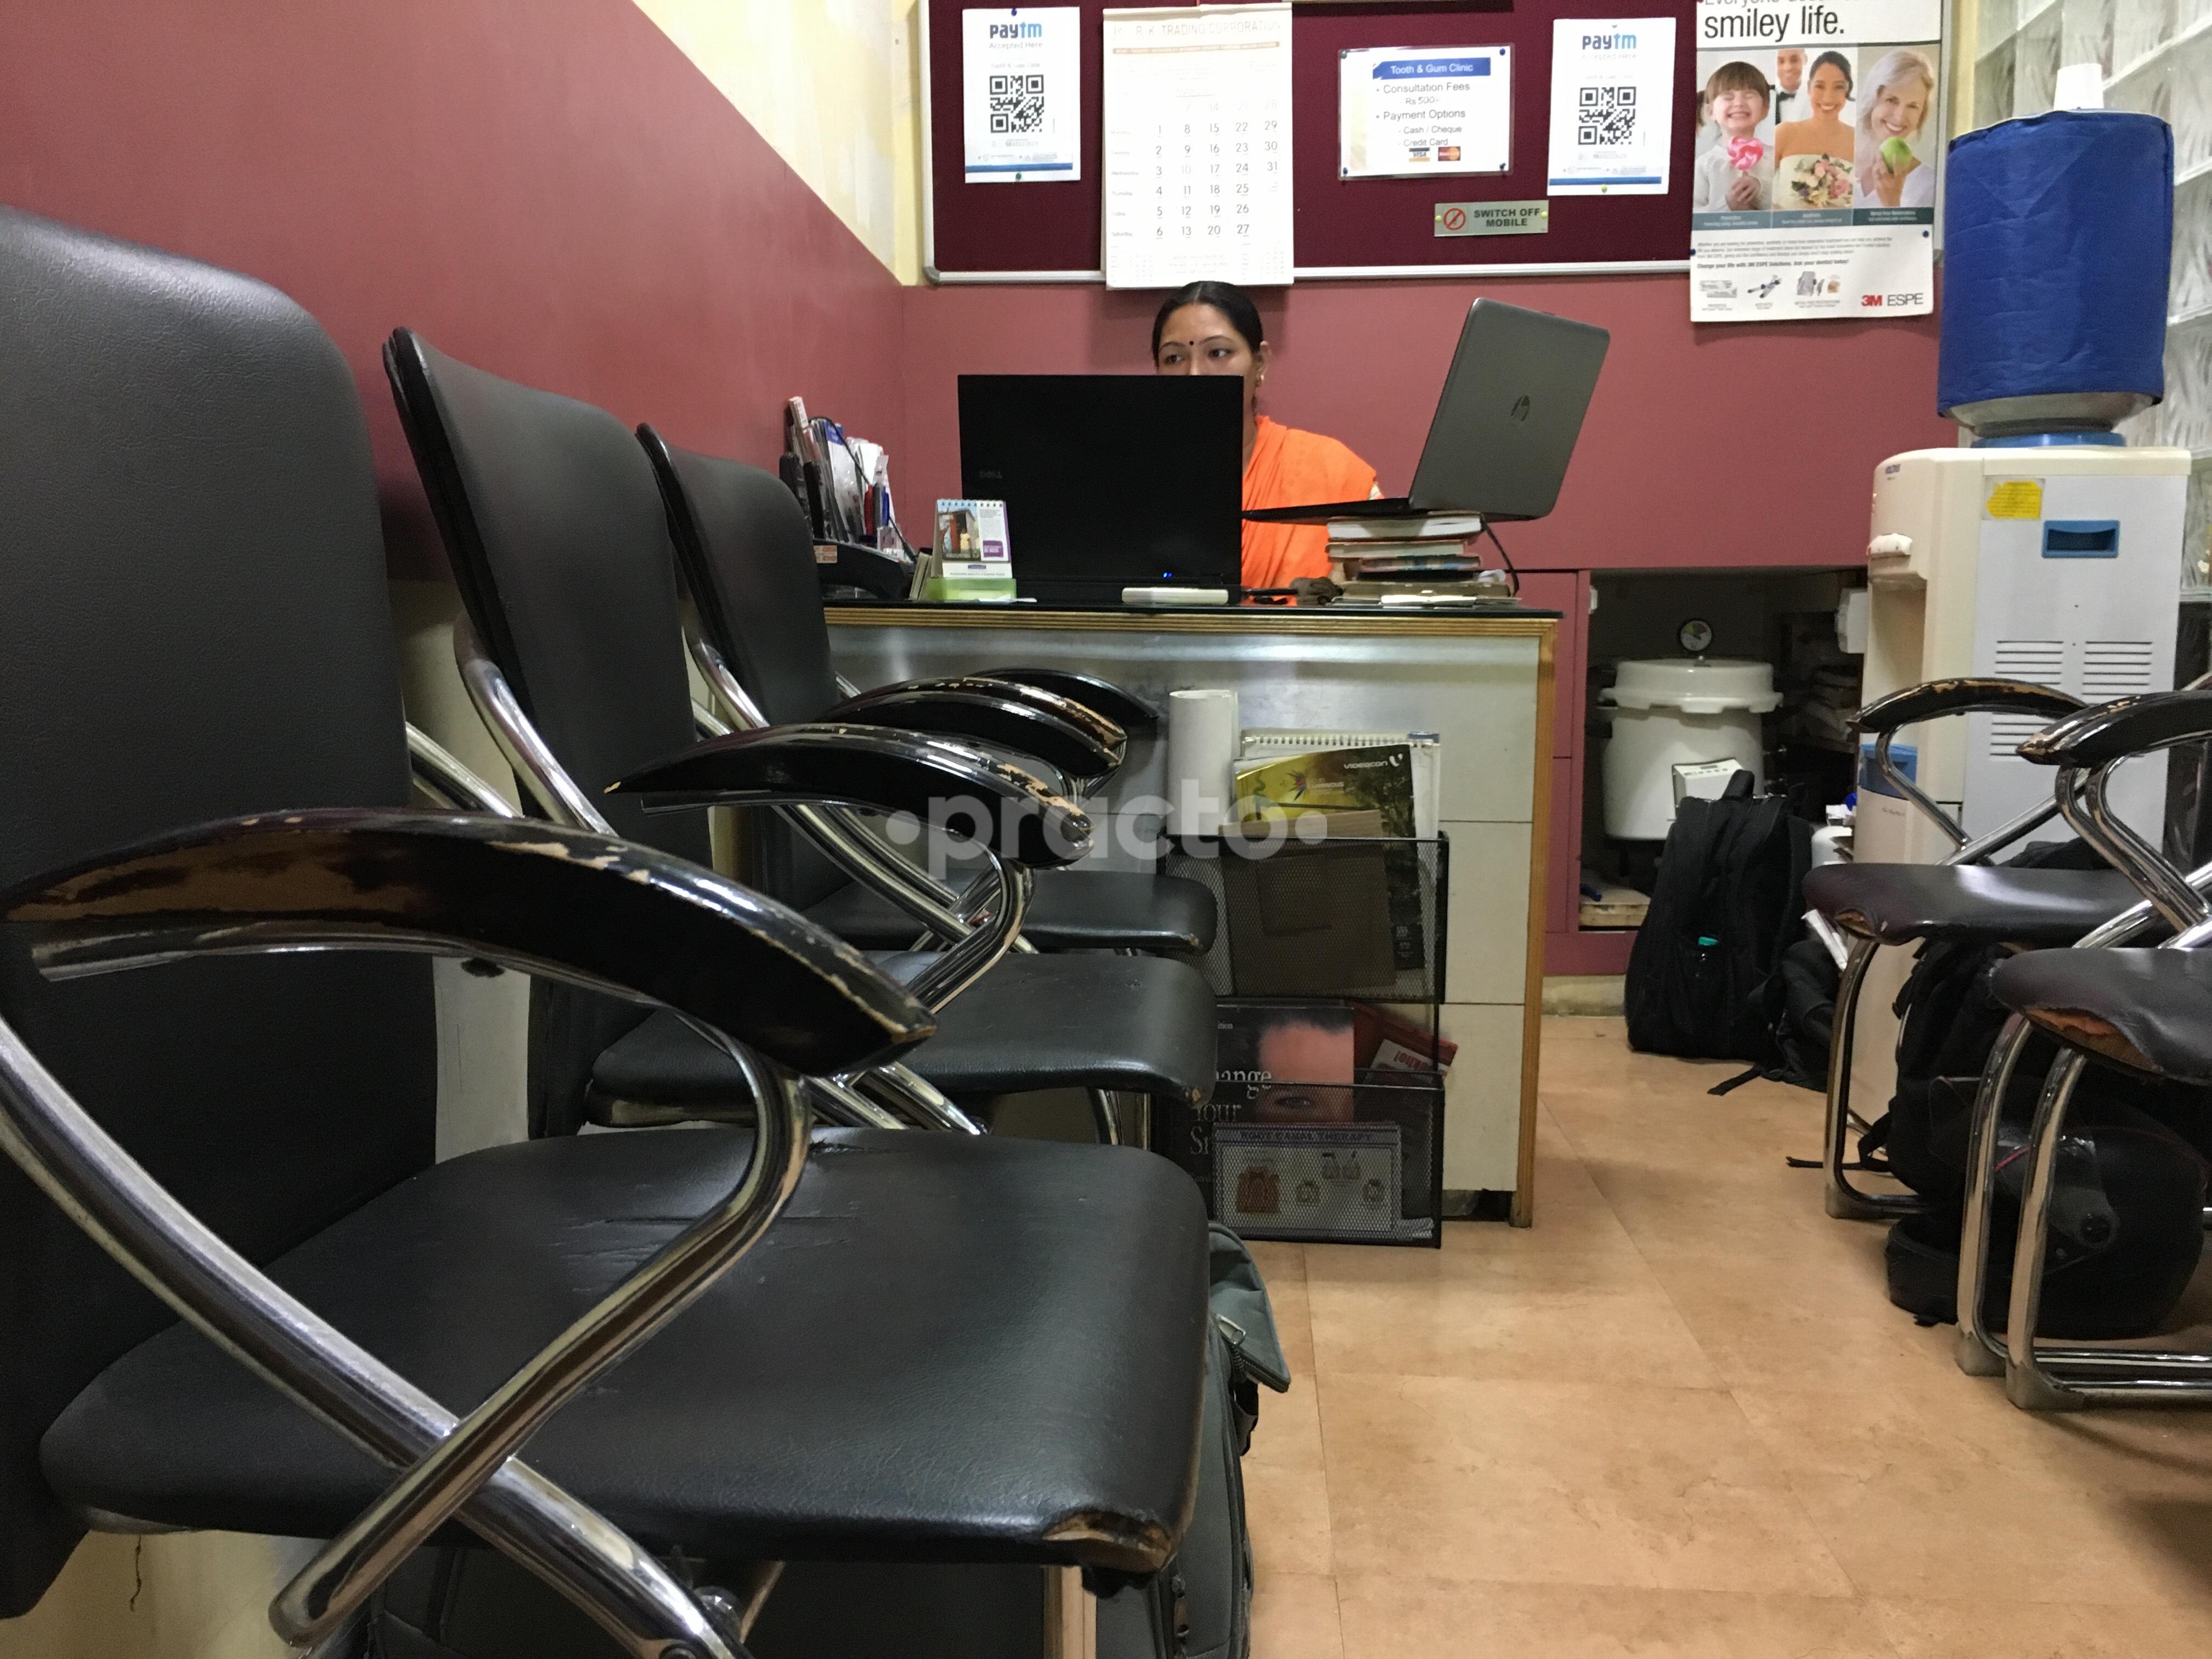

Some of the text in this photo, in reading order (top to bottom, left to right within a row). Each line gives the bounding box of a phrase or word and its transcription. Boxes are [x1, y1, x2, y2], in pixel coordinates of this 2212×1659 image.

[1161, 23, 1205, 36] TRADING
[1209, 20, 1281, 34] CORPORATION
[1705, 5, 1844, 43] smiley life.
[990, 42, 1023, 50] Accepted
[1391, 63, 1474, 75] Tooth & Gum Clinic
[1383, 82, 1470, 93] Consultation Fees
[1210, 103, 1219, 112] 14
[1383, 109, 1465, 121] Payment Options
[1158, 125, 1161, 134] 1
[1184, 125, 1190, 134] 8
[1210, 123, 1220, 133] 15
[1235, 122, 1248, 132] 22
[1265, 121, 1277, 130] 29
[1431, 126, 1463, 135] Cheque
[1155, 146, 1162, 155] 2
[1184, 145, 1191, 154] 9
[1210, 144, 1220, 153] 16
[1235, 143, 1249, 152] 23
[1265, 141, 1278, 151] 30
[1403, 138, 1448, 146] Credit Card
[1156, 166, 1163, 176] 3
[1182, 165, 1192, 174] 10
[1210, 165, 1220, 174] 17
[1235, 163, 1249, 173] 24
[1267, 161, 1277, 171] 31
[1156, 186, 1163, 195] 4
[1183, 185, 1192, 195] 11
[1210, 185, 1220, 194] 18
[1235, 183, 1249, 193] 25
[1156, 206, 1163, 216] 5
[1182, 206, 1192, 216] 12
[1210, 205, 1221, 215] 19
[1236, 204, 1249, 213] 26
[1474, 208, 1541, 218] SWITCH OFF
[1486, 218, 1527, 227] MOBILE
[1156, 227, 1163, 236] 6
[1182, 226, 1192, 235] 13
[1207, 225, 1221, 235] 20
[1237, 224, 1250, 234] 27
[1861, 294, 1923, 307] 3M ESPE
[1215, 1070, 1272, 1100] ange
